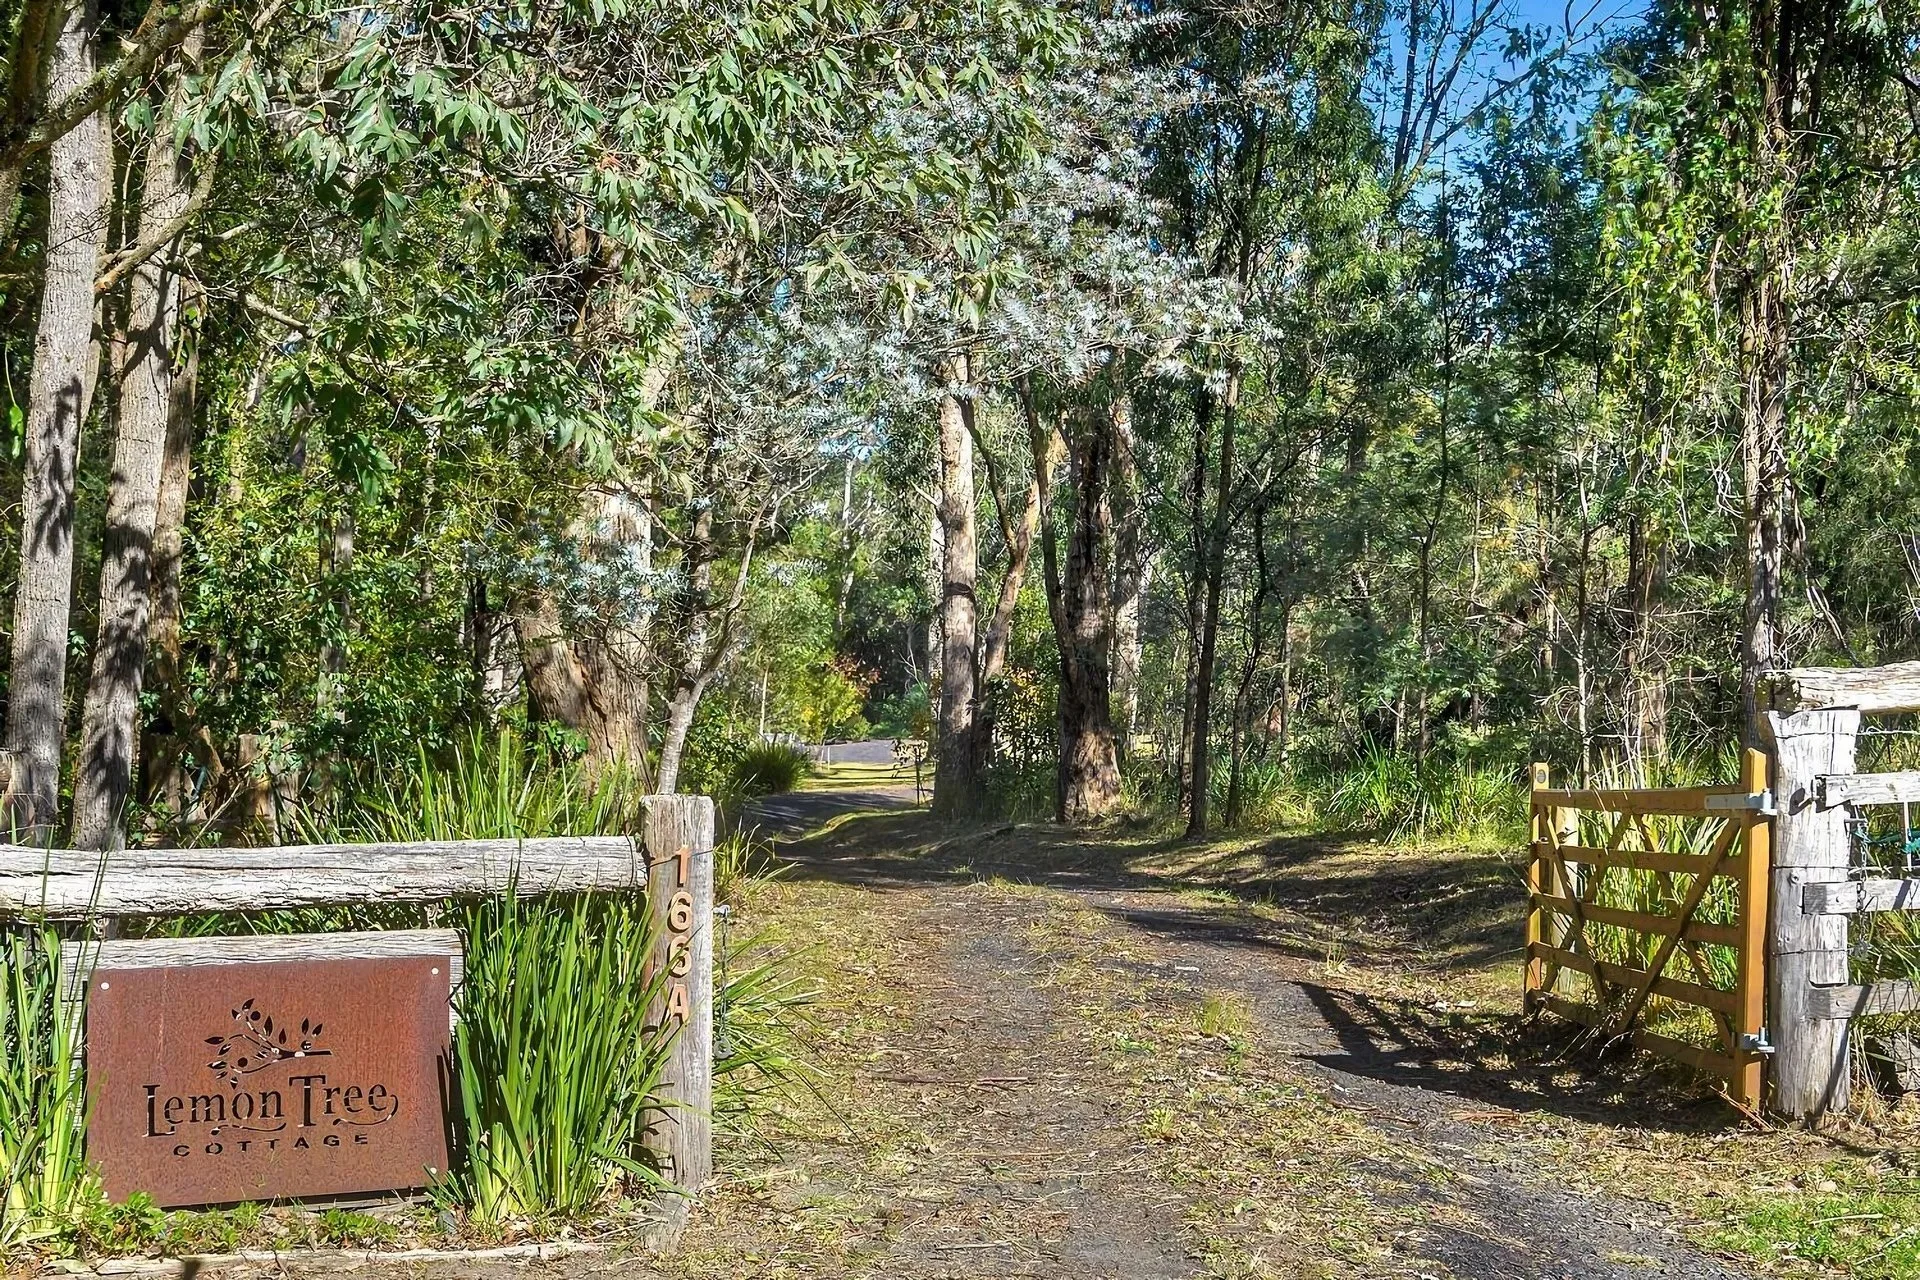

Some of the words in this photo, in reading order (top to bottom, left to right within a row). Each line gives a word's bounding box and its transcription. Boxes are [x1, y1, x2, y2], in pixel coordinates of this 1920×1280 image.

[669, 845, 692, 1022] 166A
[142, 1083, 286, 1138] Lemon
[289, 1074, 398, 1127] Tree
[173, 1132, 370, 1157] COTTAGE
